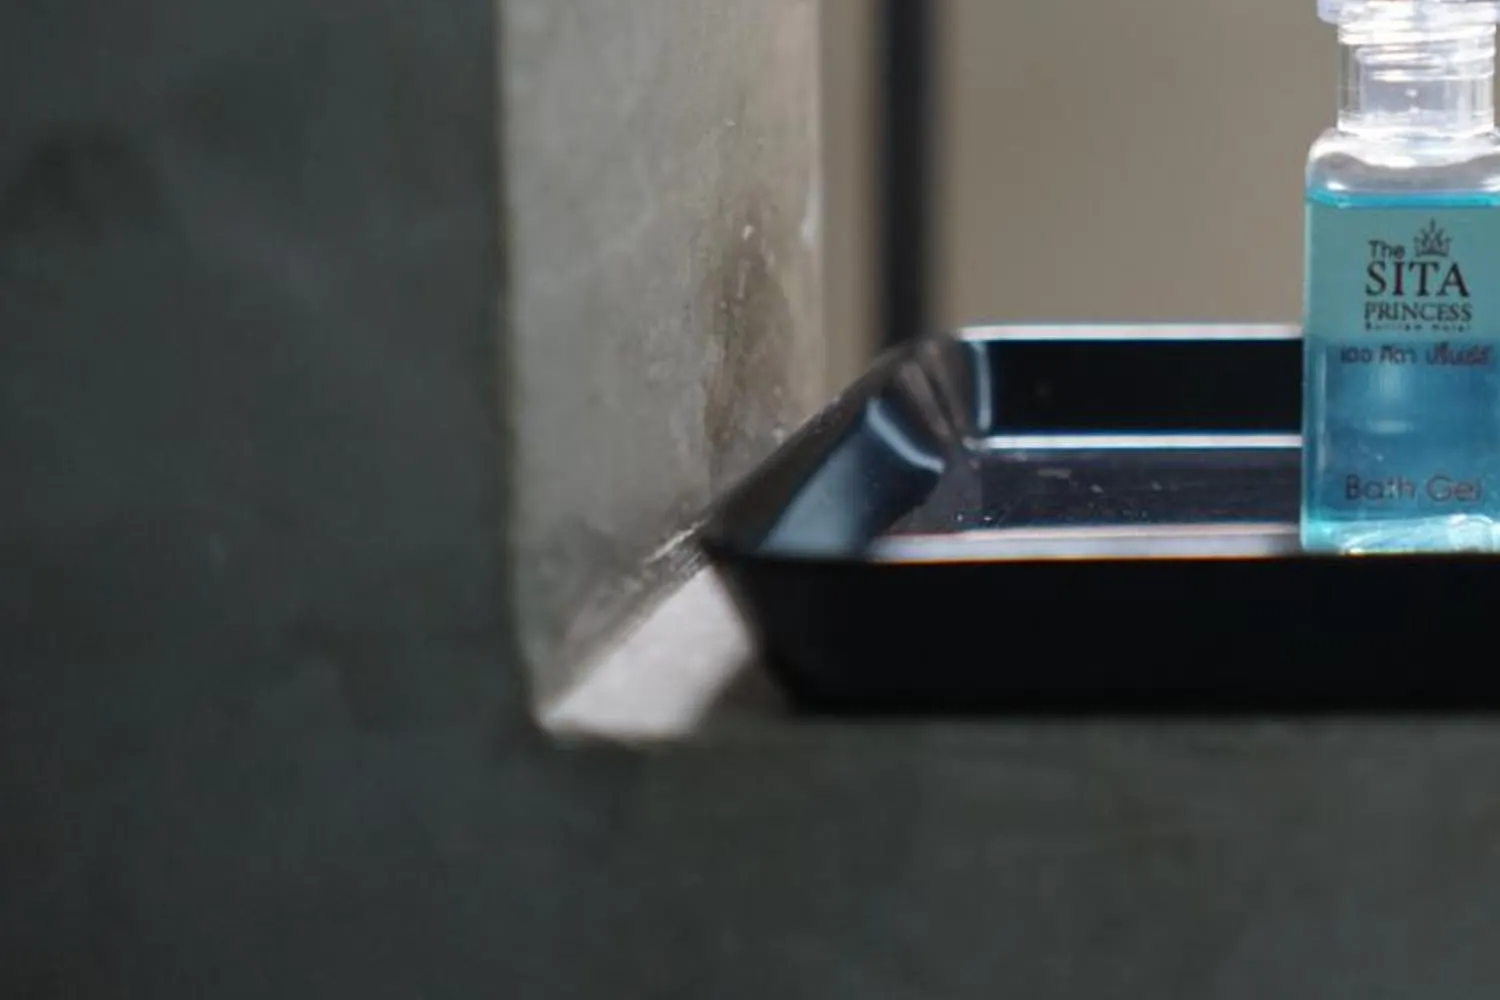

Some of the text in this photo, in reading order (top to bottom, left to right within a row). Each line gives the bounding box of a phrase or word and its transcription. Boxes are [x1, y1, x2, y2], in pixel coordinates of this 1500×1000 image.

[1367, 239, 1406, 259] The
[1365, 260, 1471, 297] SITA
[1364, 301, 1472, 321] PRINCESS
[1345, 474, 1482, 502] Bath Gel
